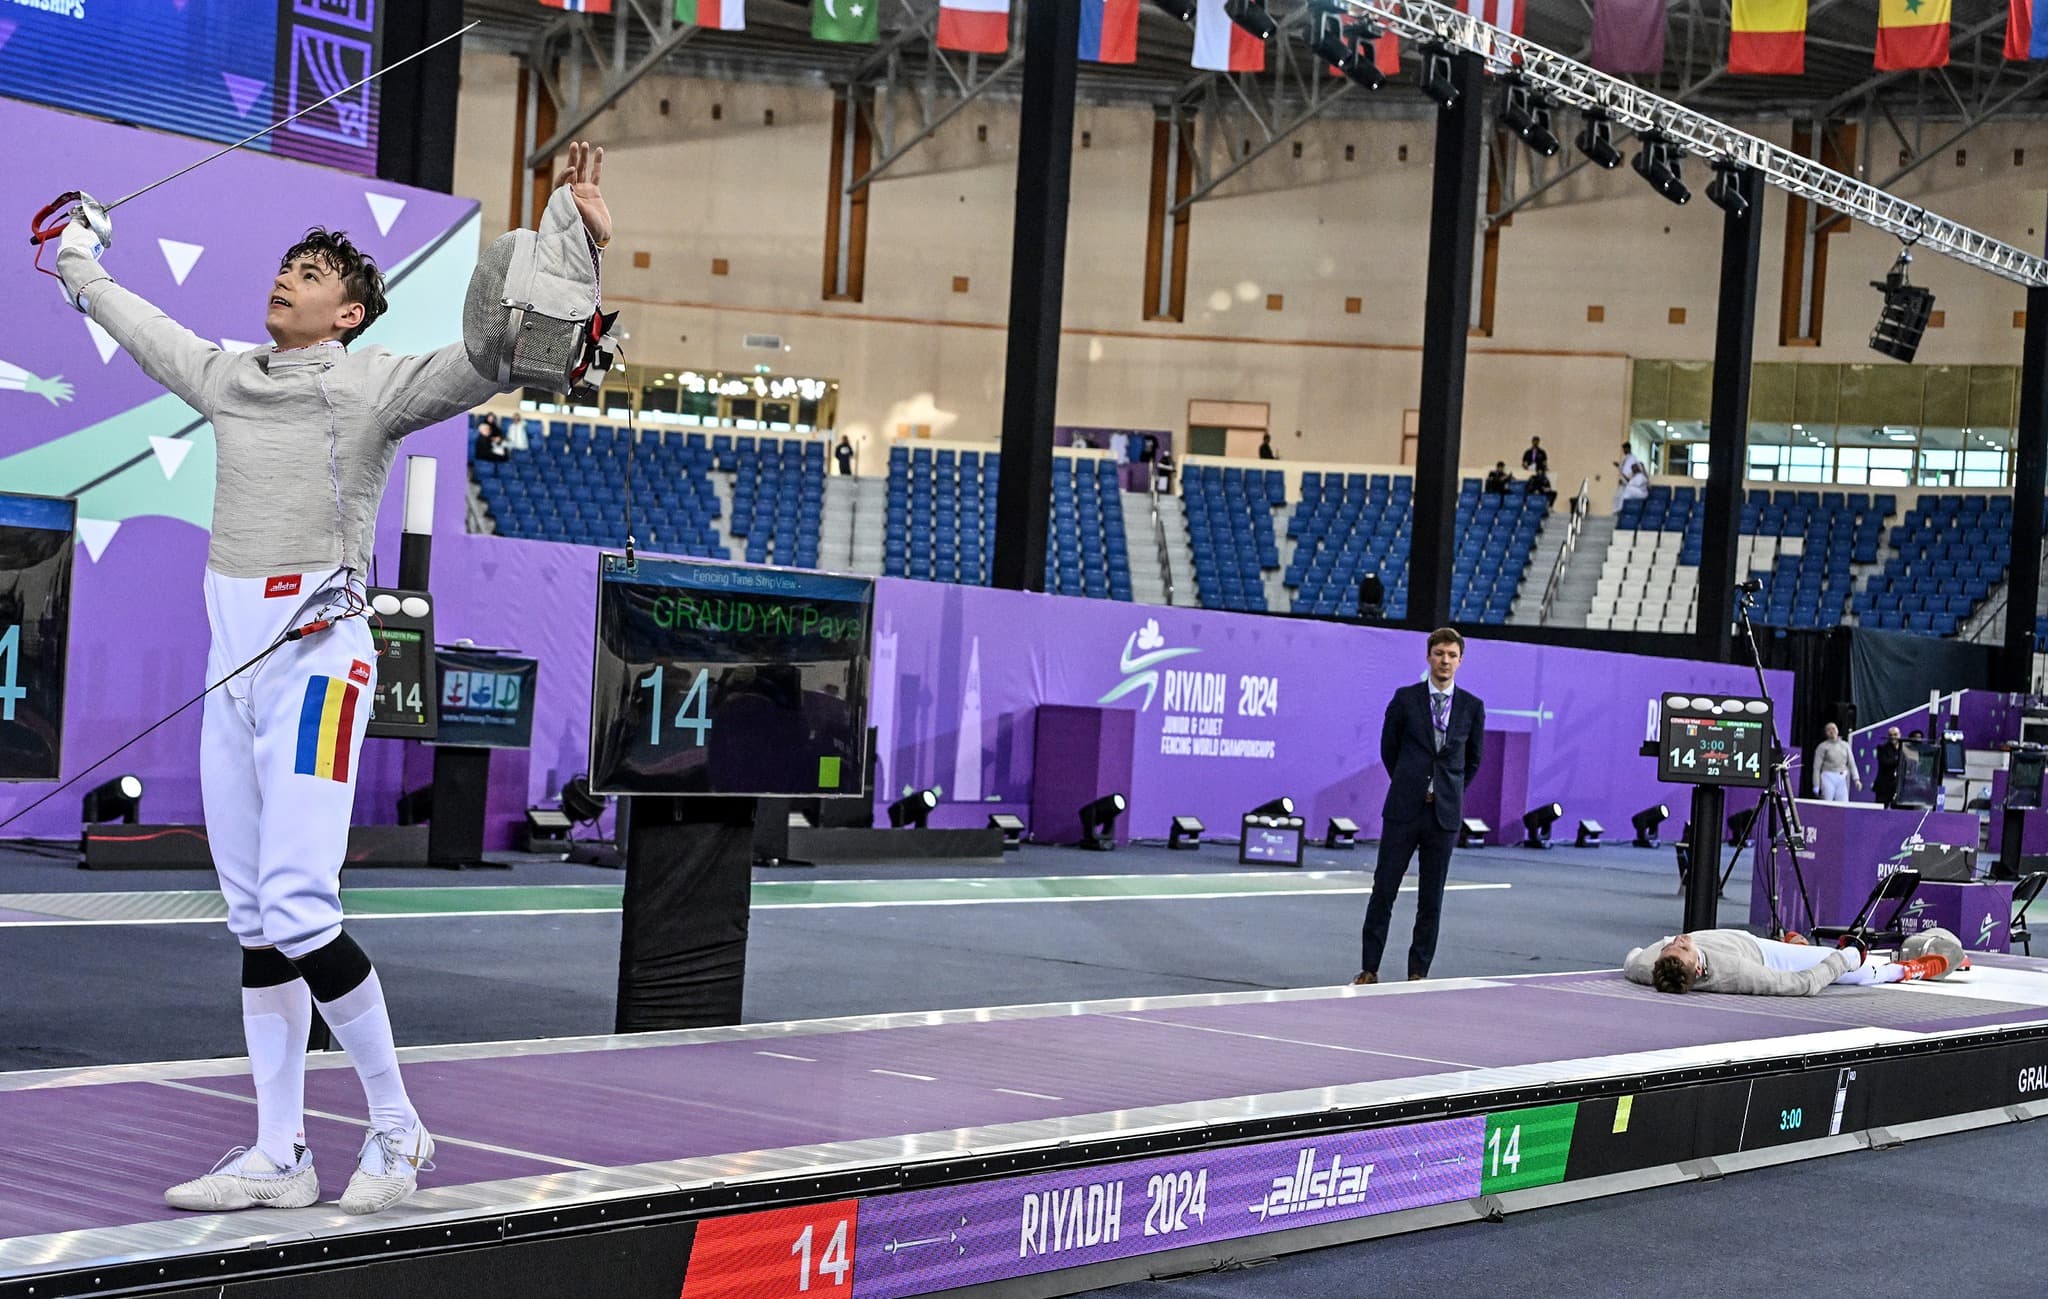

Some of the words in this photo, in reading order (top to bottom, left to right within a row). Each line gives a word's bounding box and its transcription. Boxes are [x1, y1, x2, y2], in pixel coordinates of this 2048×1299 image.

[693, 569, 729, 586] Fencing
[731, 572, 752, 586] Time
[755, 575, 796, 590] StripView
[653, 596, 793, 636] GRAUDYN
[391, 682, 423, 713] 14
[641, 665, 713, 747] 14
[1163, 669, 1226, 714] RIYADH
[1238, 674, 1278, 716] 2024
[1162, 715, 1190, 734] JUNIOR
[1199, 717, 1224, 736] CADET
[1161, 735, 1192, 755] FENCING
[1193, 738, 1219, 756] WORLD
[1220, 739, 1275, 759] CHAMPIONSHIPS
[1670, 747, 1697, 768] 14
[1734, 751, 1760, 773] 14
[1700, 740, 1725, 750] 3:00
[1708, 767, 1720, 776] 2/3
[1780, 1107, 1802, 1131] 3:00
[1488, 1124, 1521, 1177] 14
[1262, 1147, 1374, 1219] allstar
[1019, 1180, 1124, 1258] RIYADH
[1144, 1168, 1208, 1237] 2024
[791, 1219, 850, 1292] 14
